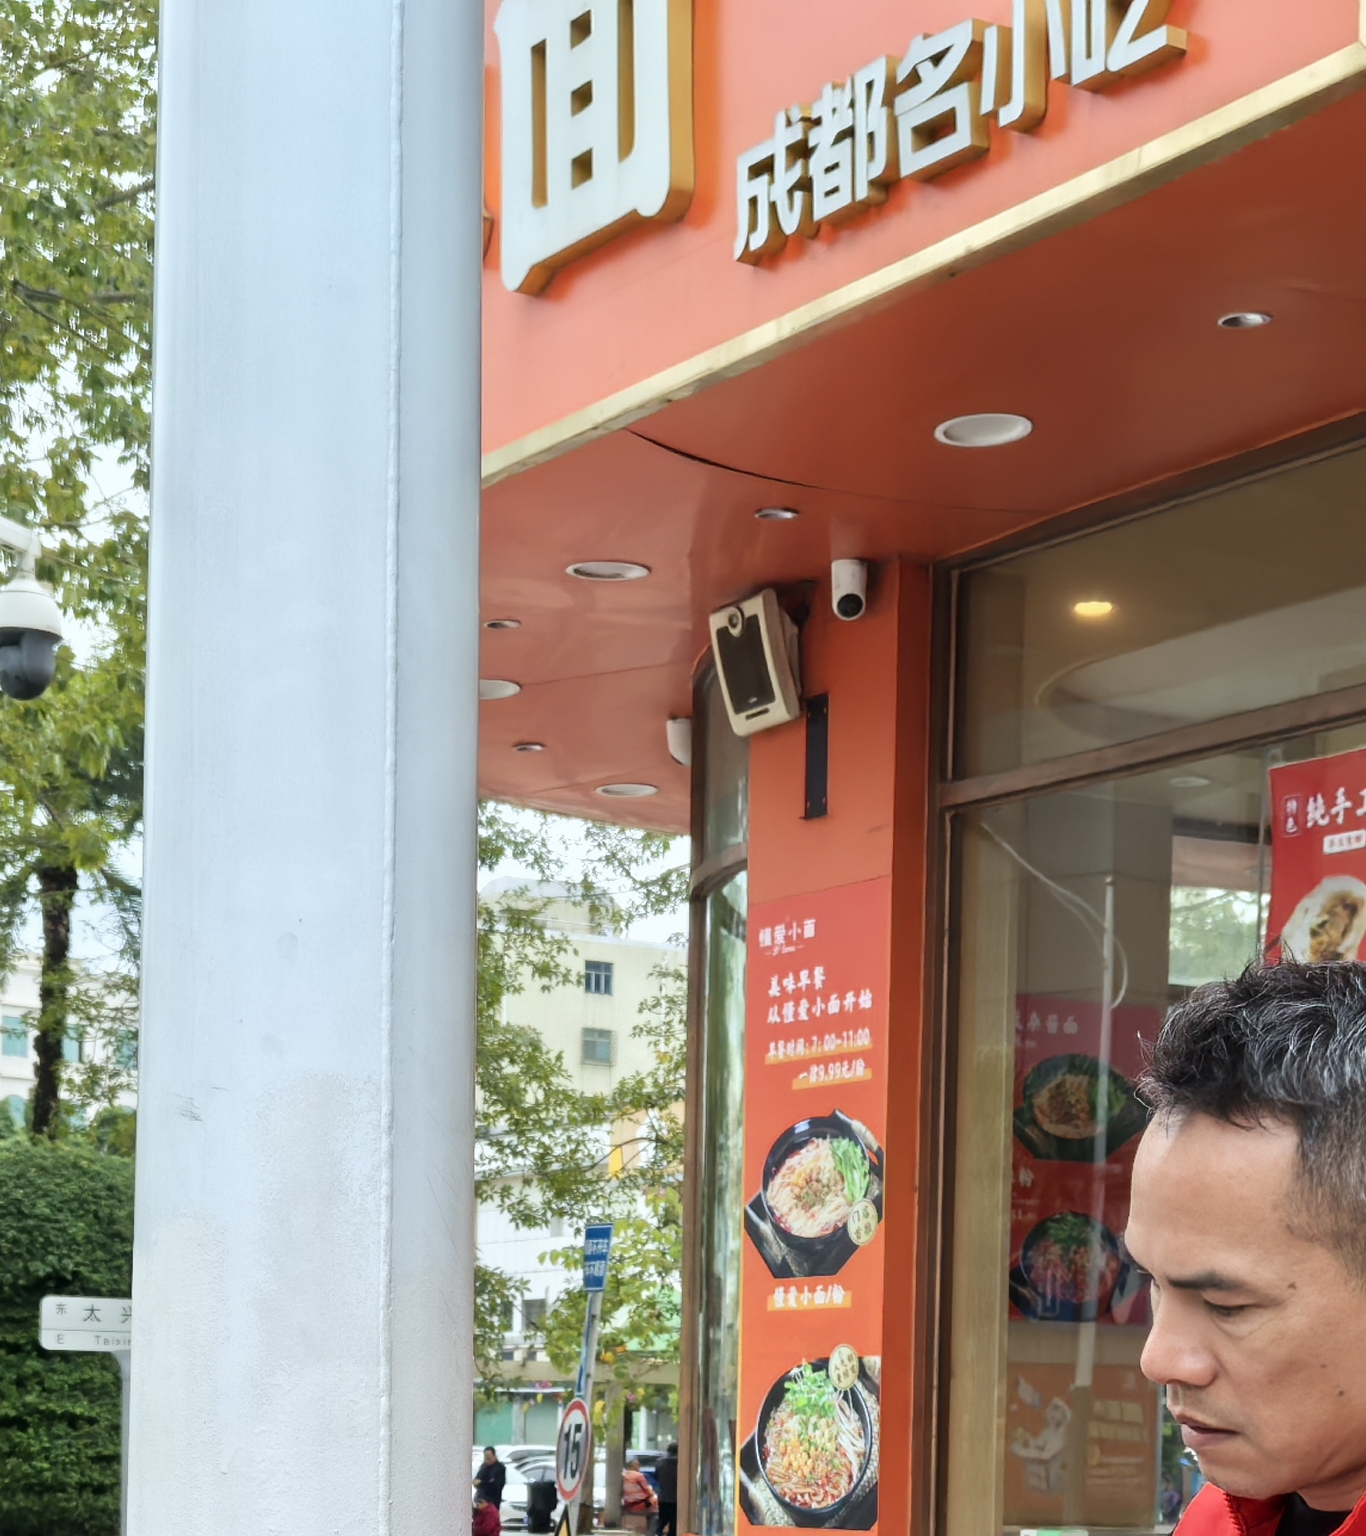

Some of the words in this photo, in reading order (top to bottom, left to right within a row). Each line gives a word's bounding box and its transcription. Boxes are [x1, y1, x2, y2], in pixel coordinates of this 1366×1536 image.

[767, 965, 826, 998] 美味早餐
[563, 1422, 584, 1481] 15
